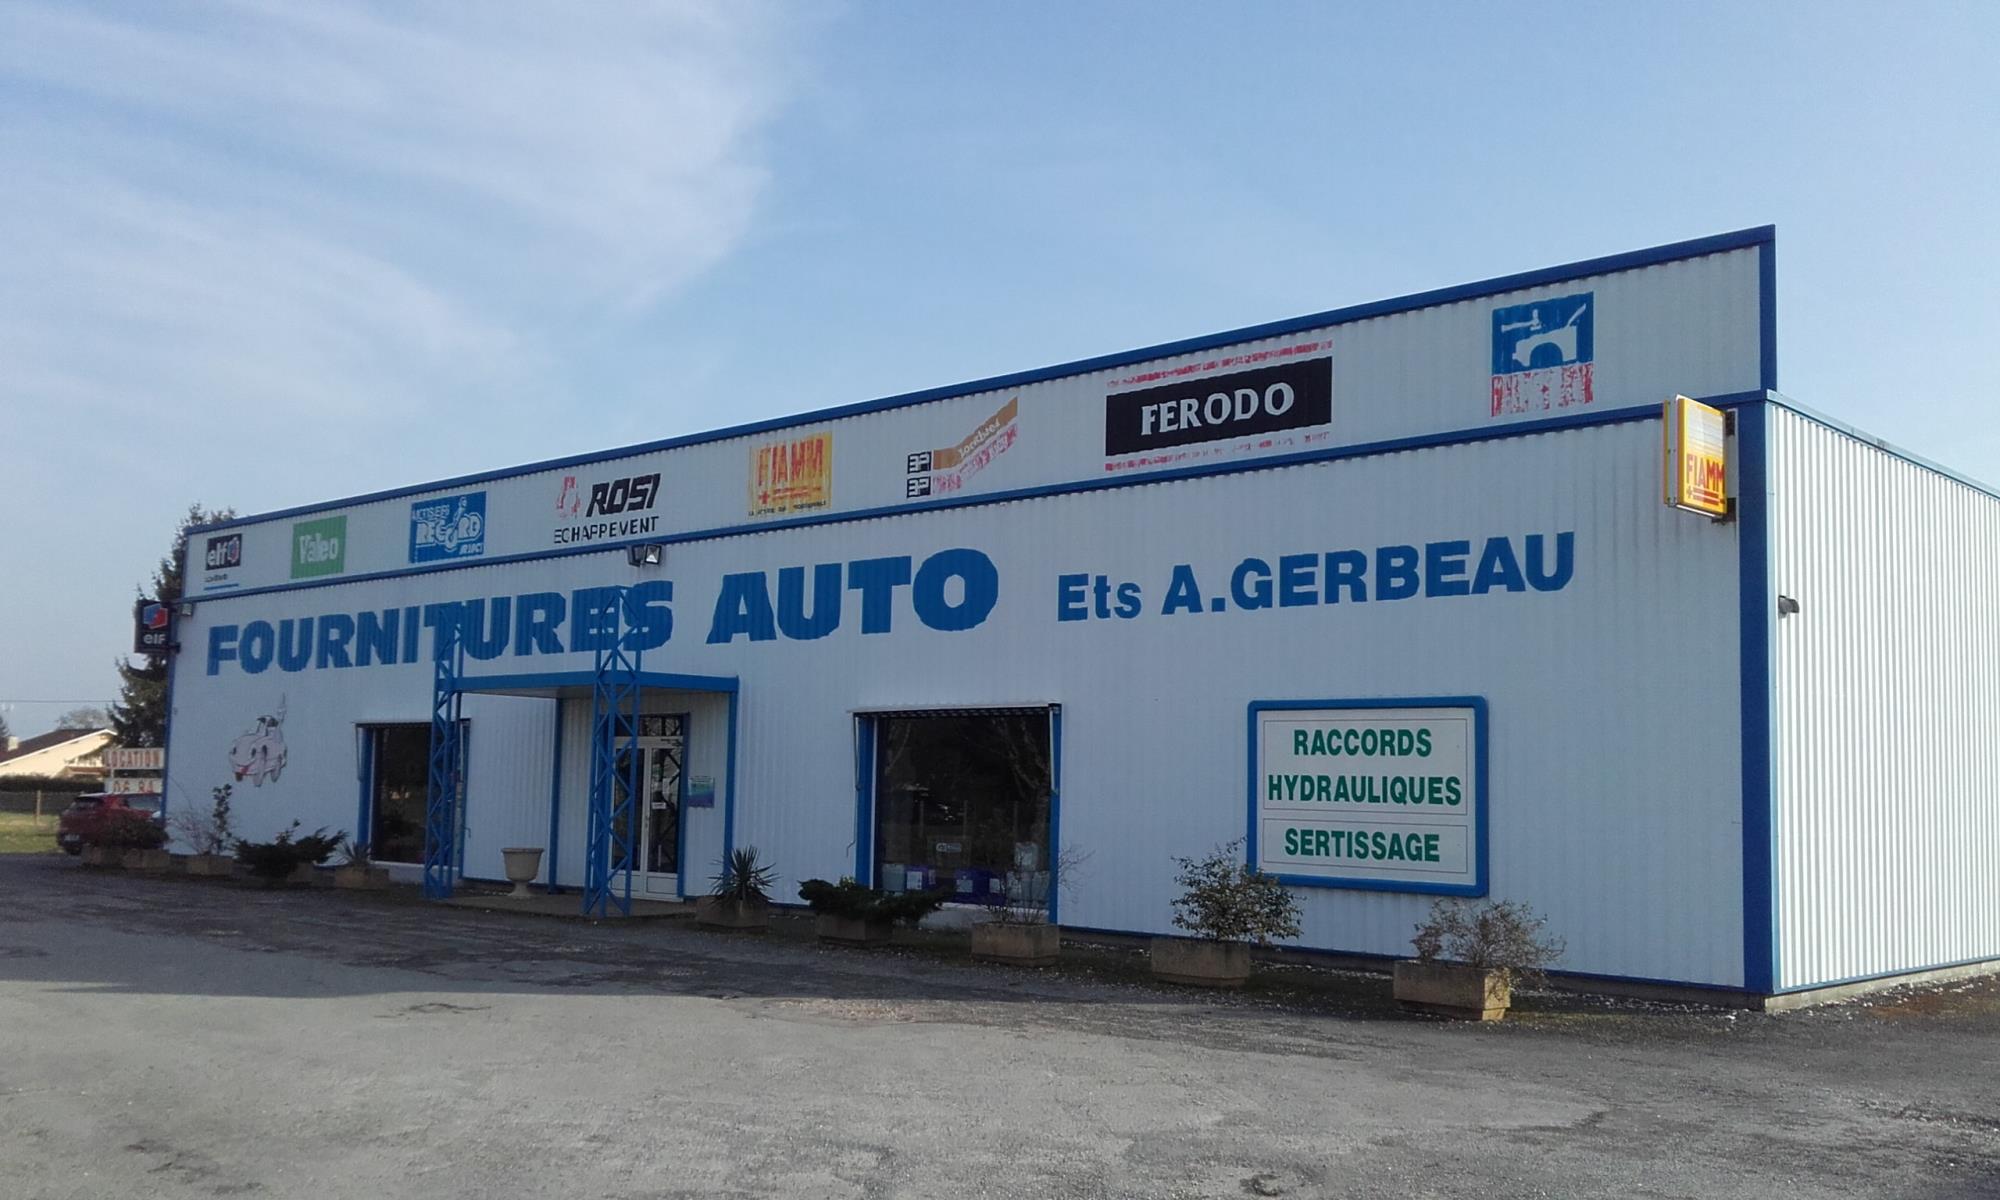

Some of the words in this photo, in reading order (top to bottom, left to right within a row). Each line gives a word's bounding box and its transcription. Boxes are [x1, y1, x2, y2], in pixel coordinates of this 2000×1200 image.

[1141, 382, 1295, 436] FERODO
[1686, 453, 1726, 494] FIAMM
[586, 473, 661, 518] ROSI
[207, 541, 228, 567] elf
[207, 580, 673, 676] FOURNITURES
[706, 548, 999, 644] AUTO
[1058, 573, 1141, 622] Ets
[1294, 728, 1432, 758] RACCORDS
[1268, 774, 1462, 806] HYDRAULIQUES
[1284, 828, 1440, 862] SERTISSAGE
